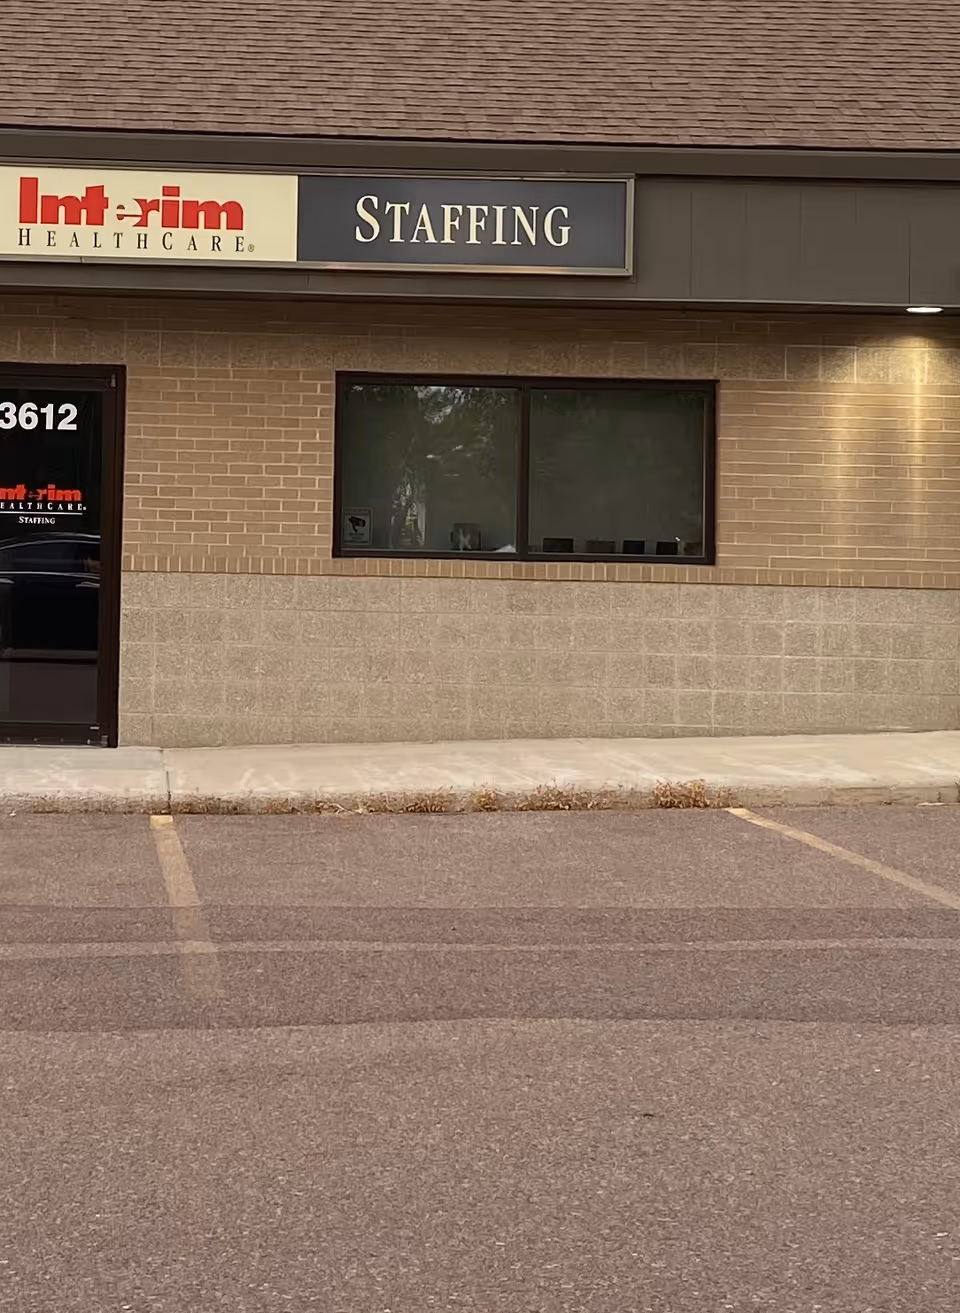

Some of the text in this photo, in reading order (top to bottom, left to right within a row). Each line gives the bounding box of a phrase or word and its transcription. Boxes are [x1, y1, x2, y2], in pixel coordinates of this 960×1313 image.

[18, 177, 244, 230] Interim
[354, 194, 572, 247] STAFFING
[18, 515, 56, 525] STAFFING
